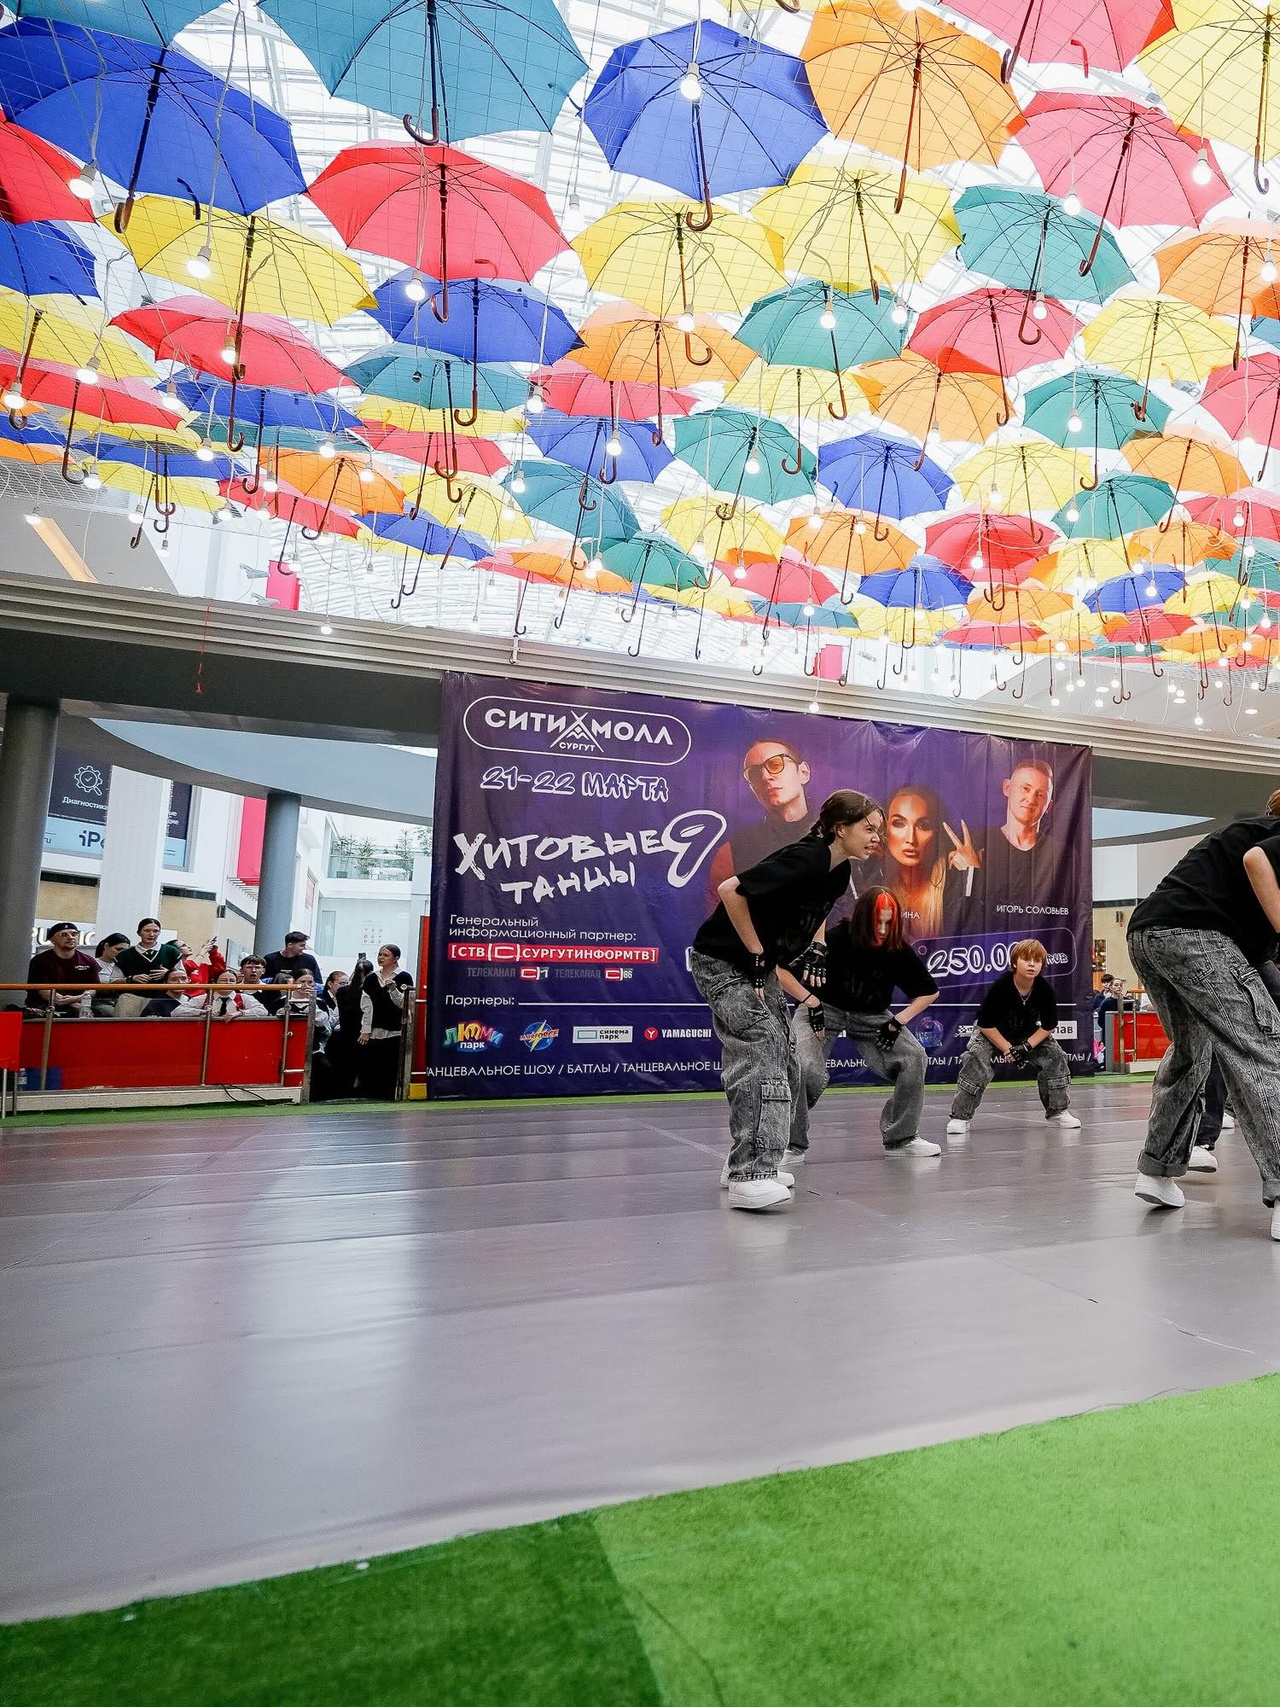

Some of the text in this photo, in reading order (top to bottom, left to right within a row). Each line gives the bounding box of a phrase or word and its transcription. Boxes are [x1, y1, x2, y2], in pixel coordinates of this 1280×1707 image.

[484, 708, 674, 746] СИТИ МОЛЛ
[559, 741, 596, 752] СУРГУТ
[480, 766, 669, 802] 21-22 МАРТА
[453, 829, 663, 881] ХИТОВЫЕ
[500, 860, 636, 905] ТАНЦЫ
[996, 905, 1069, 915] ИГОРЬ СОЛОВЬЕВ
[450, 915, 539, 928] Генеральный
[449, 926, 637, 942] информационный партнер:
[467, 967, 516, 977] ТЕЛЕКАНАЛ
[555, 968, 601, 979] ТЕЛЕКАНАЛ
[445, 995, 515, 1007] Партнеры:
[661, 1028, 712, 1039] YAMAGUCHI
[460, 1041, 486, 1050] парк
[523, 1064, 556, 1075] ШОУ
[567, 1063, 611, 1074] БАТТЛЫ
[622, 1061, 711, 1073] ТАНЦЕВАЛЬНОЕ
